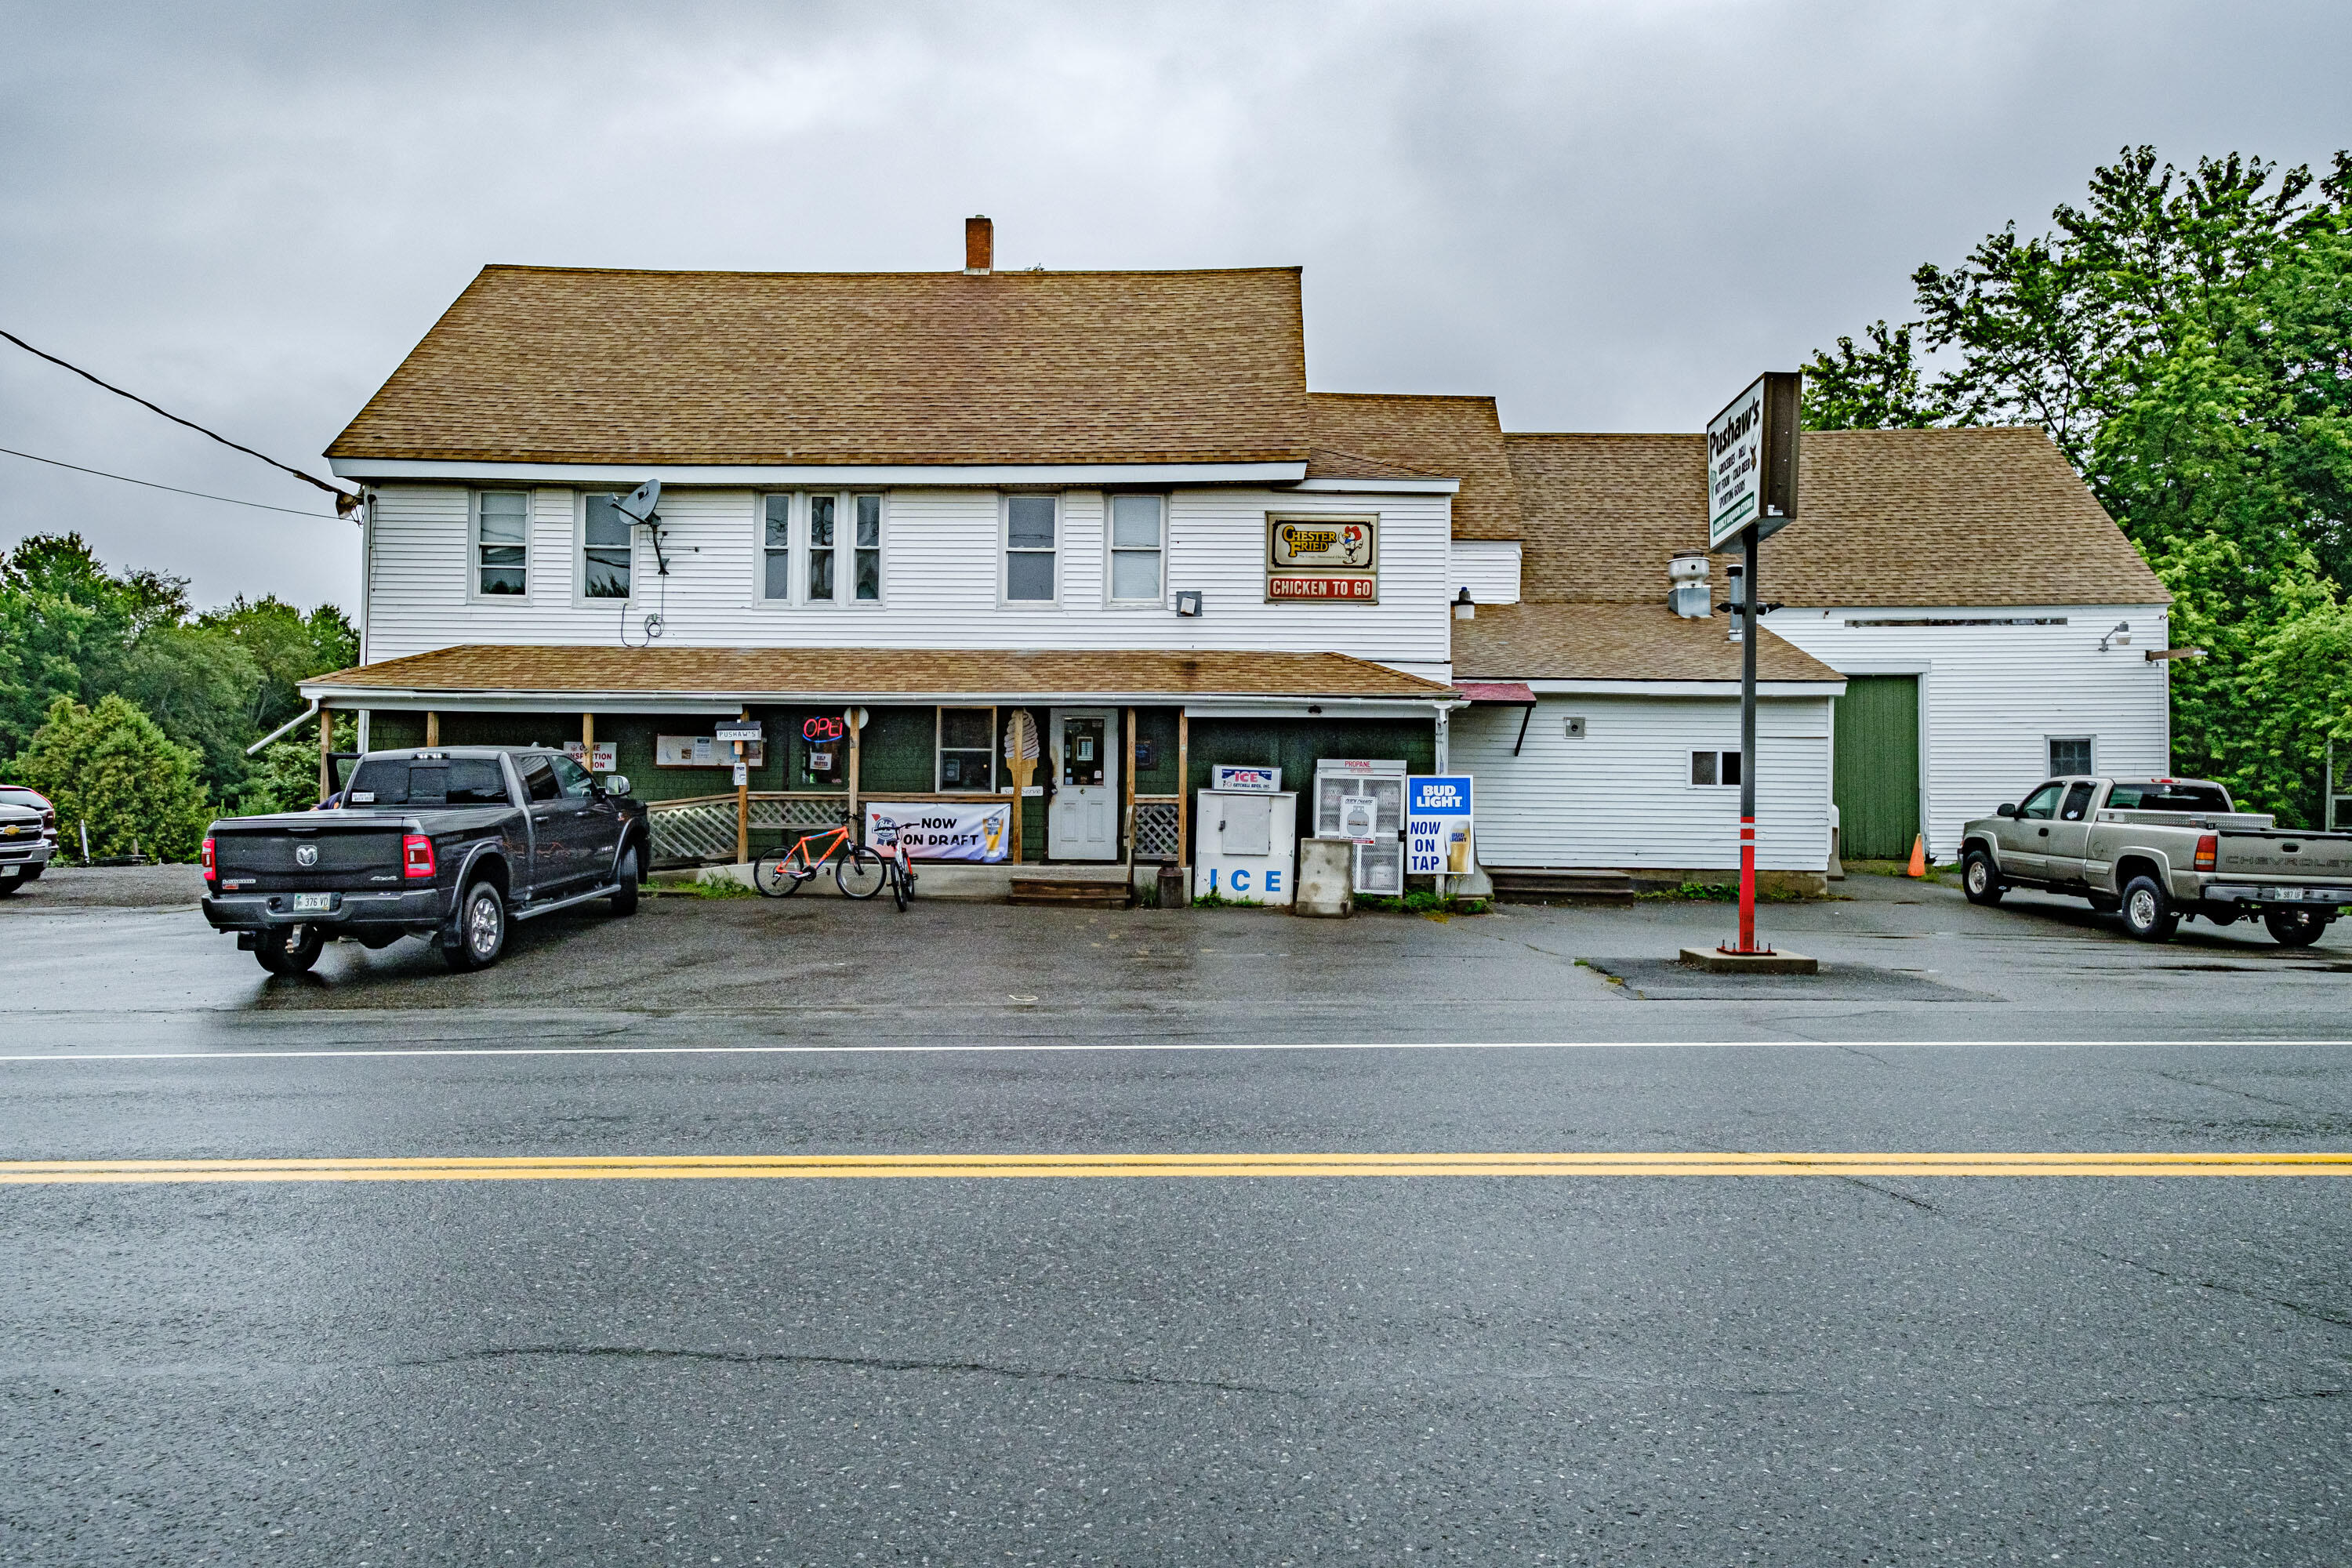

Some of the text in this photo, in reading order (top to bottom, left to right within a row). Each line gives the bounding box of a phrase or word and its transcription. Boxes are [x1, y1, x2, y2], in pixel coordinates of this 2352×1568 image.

[1710, 396, 1759, 464] Pushaw's
[1719, 452, 1735, 475] GROCERIES
[1733, 465, 1741, 481] COLD
[1741, 458, 1750, 474] BEER
[1719, 478, 1745, 510] SPORTING GOODS
[1726, 505, 1740, 524] LIQUOR
[1740, 495, 1753, 514] STORE
[1283, 525, 1337, 543] CHESTER
[1289, 542, 1329, 557] FRIED
[1272, 580, 1370, 596] CHICKEN TO GO
[1235, 771, 1259, 782] ICE
[1423, 786, 1456, 796] BUD
[1417, 797, 1462, 808] LIGHT
[921, 818, 957, 829] NOW
[1410, 822, 1441, 835] NOW
[903, 834, 979, 845] ON DRAFT
[1415, 839, 1435, 852] ON
[1412, 856, 1439, 870] TAP
[2225, 855, 2352, 868] CHEVROLET
[1210, 869, 1282, 892] ICE
[305, 897, 328, 906] 376 VD
